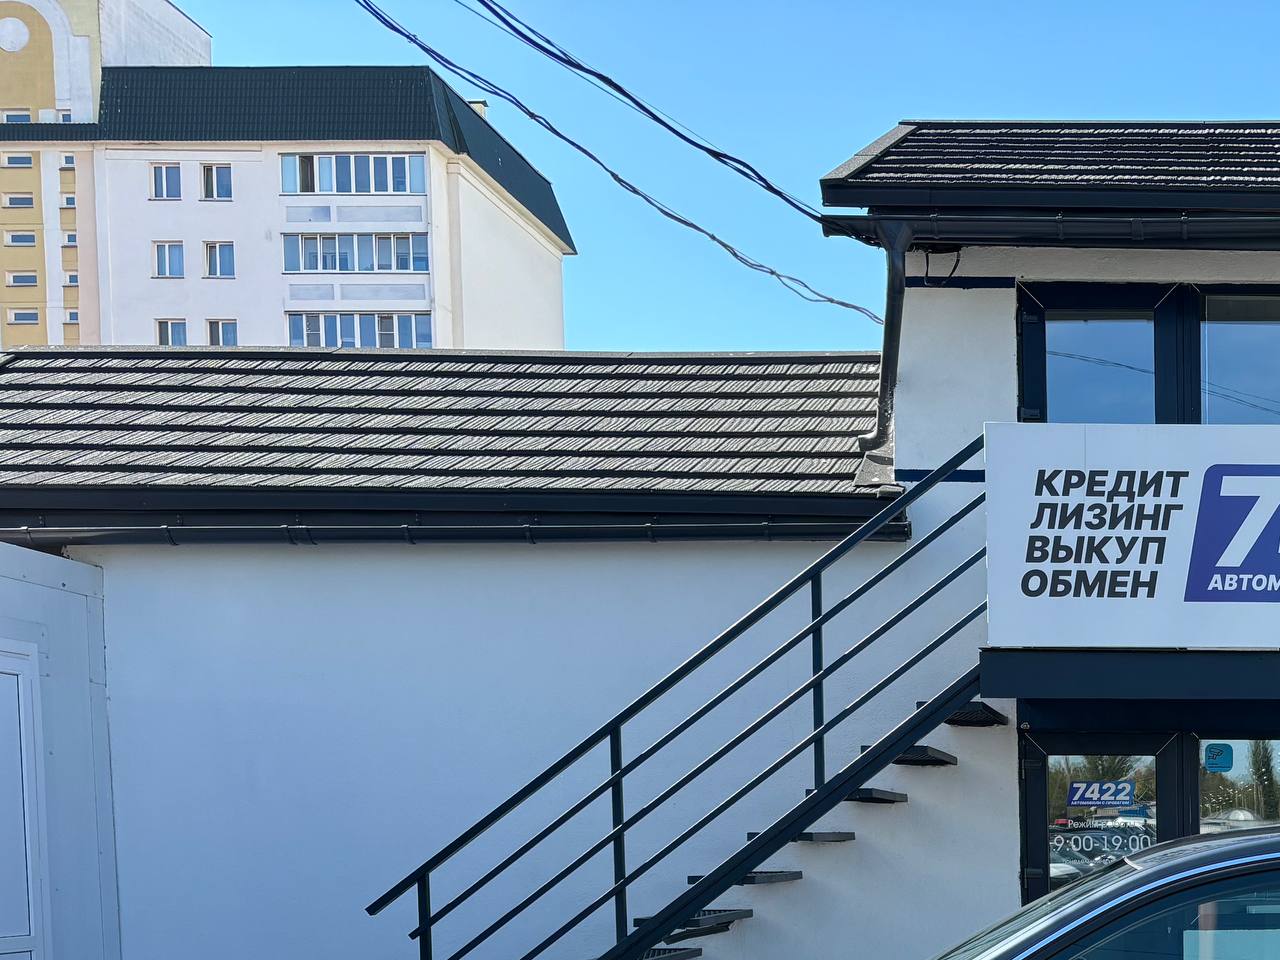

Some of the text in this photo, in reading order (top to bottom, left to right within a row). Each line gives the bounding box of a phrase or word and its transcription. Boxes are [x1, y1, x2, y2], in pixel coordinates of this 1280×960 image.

[1034, 469, 1190, 503] КРЕДИТ
[1030, 502, 1184, 531] ЛИЗИНГ
[1025, 535, 1167, 565] ВЫКУП
[1020, 569, 1159, 599] ОБМЕН
[1072, 782, 1131, 801] 7422
[1068, 819, 1098, 829] Режим
[1053, 835, 1151, 852] 9:00-19:00
